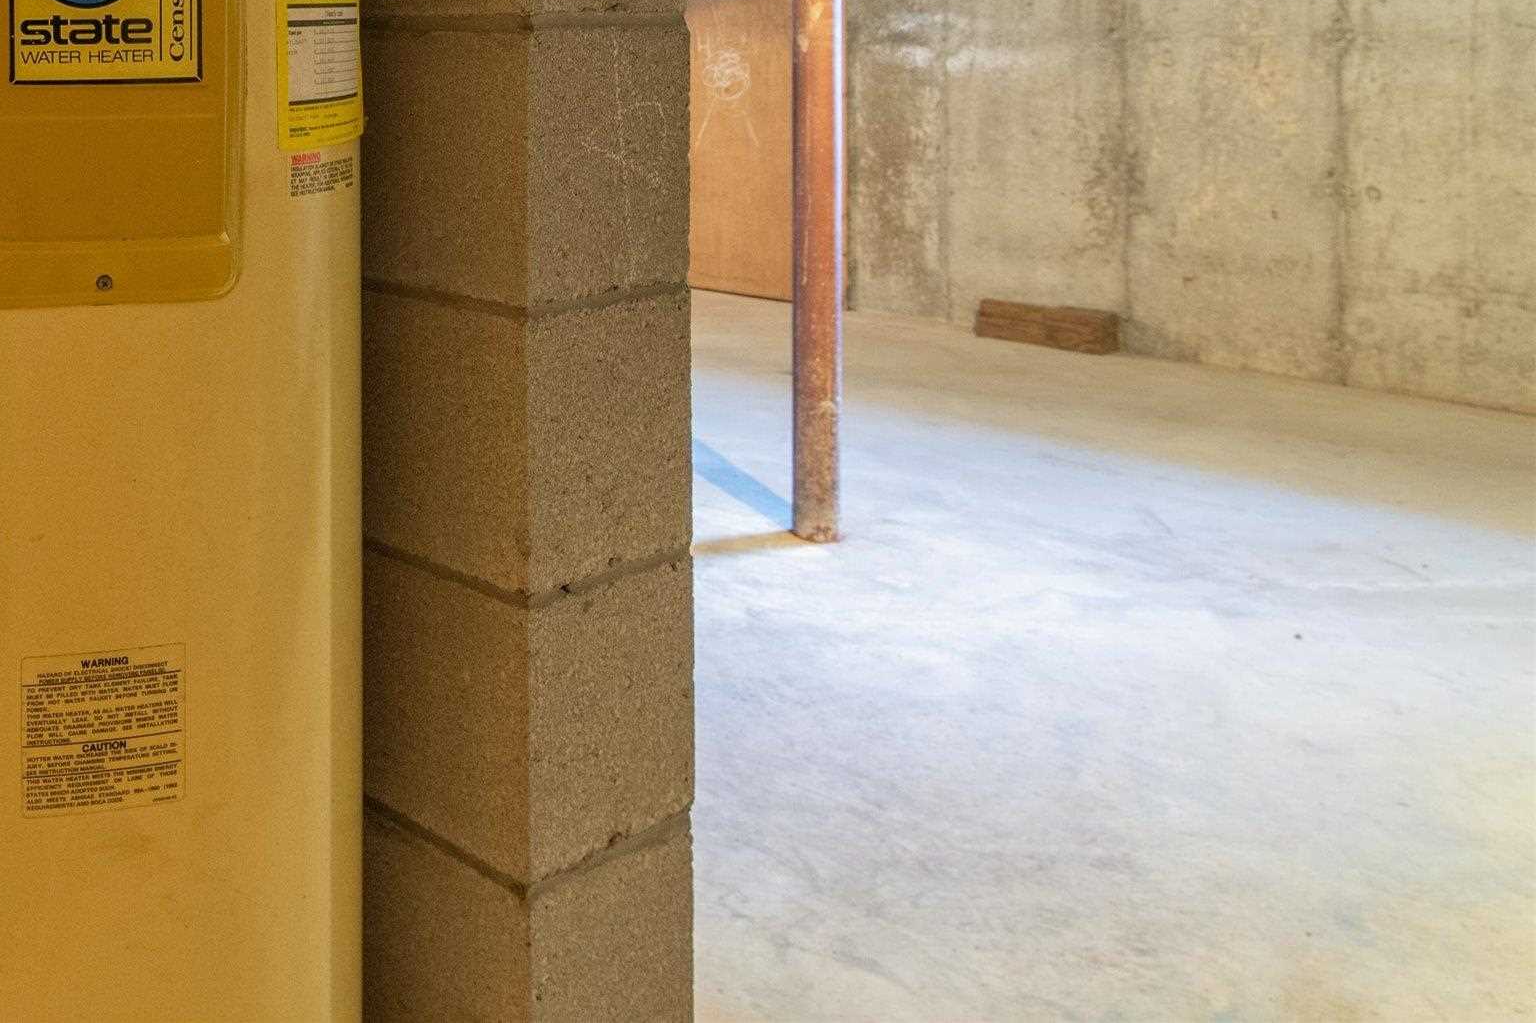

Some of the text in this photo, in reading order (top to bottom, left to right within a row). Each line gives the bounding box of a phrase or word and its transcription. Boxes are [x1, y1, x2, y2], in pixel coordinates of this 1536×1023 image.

[20, 15, 154, 46] state
[21, 49, 154, 64] WATER HEATER
[81, 656, 129, 669] WARNING
[81, 740, 127, 753] CAUTION
[38, 766, 79, 775] TRUCTION
